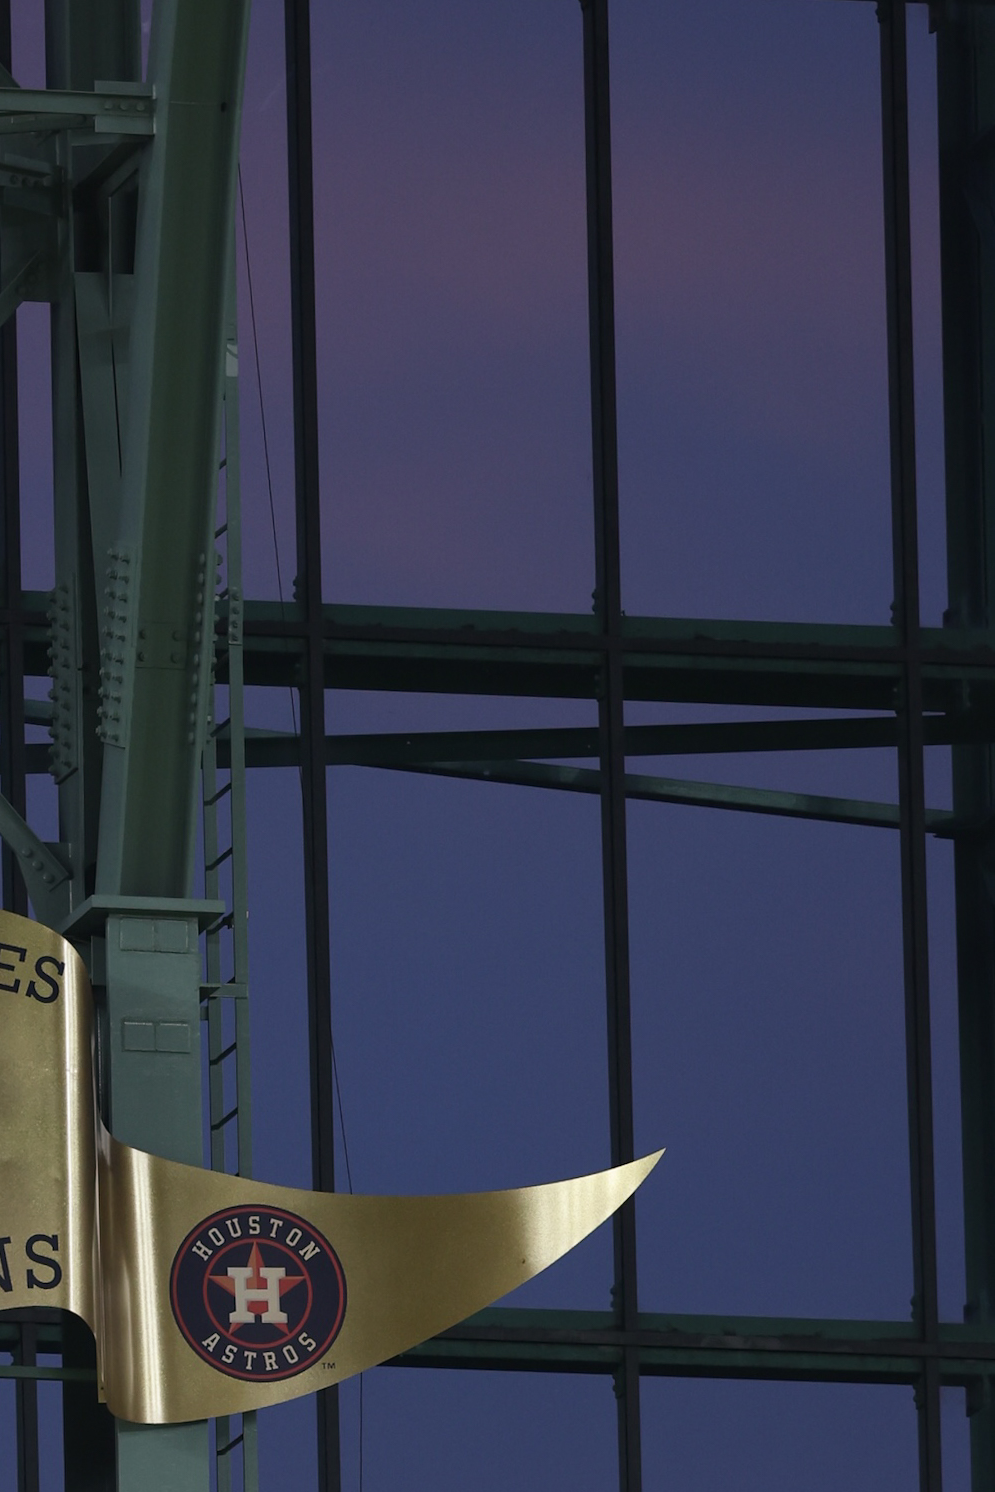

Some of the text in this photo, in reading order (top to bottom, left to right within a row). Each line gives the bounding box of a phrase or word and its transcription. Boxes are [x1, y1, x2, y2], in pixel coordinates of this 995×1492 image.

[191, 1215, 321, 1262] HOUSTON
[226, 1266, 289, 1324] H
[201, 1332, 317, 1372] ASTROS
